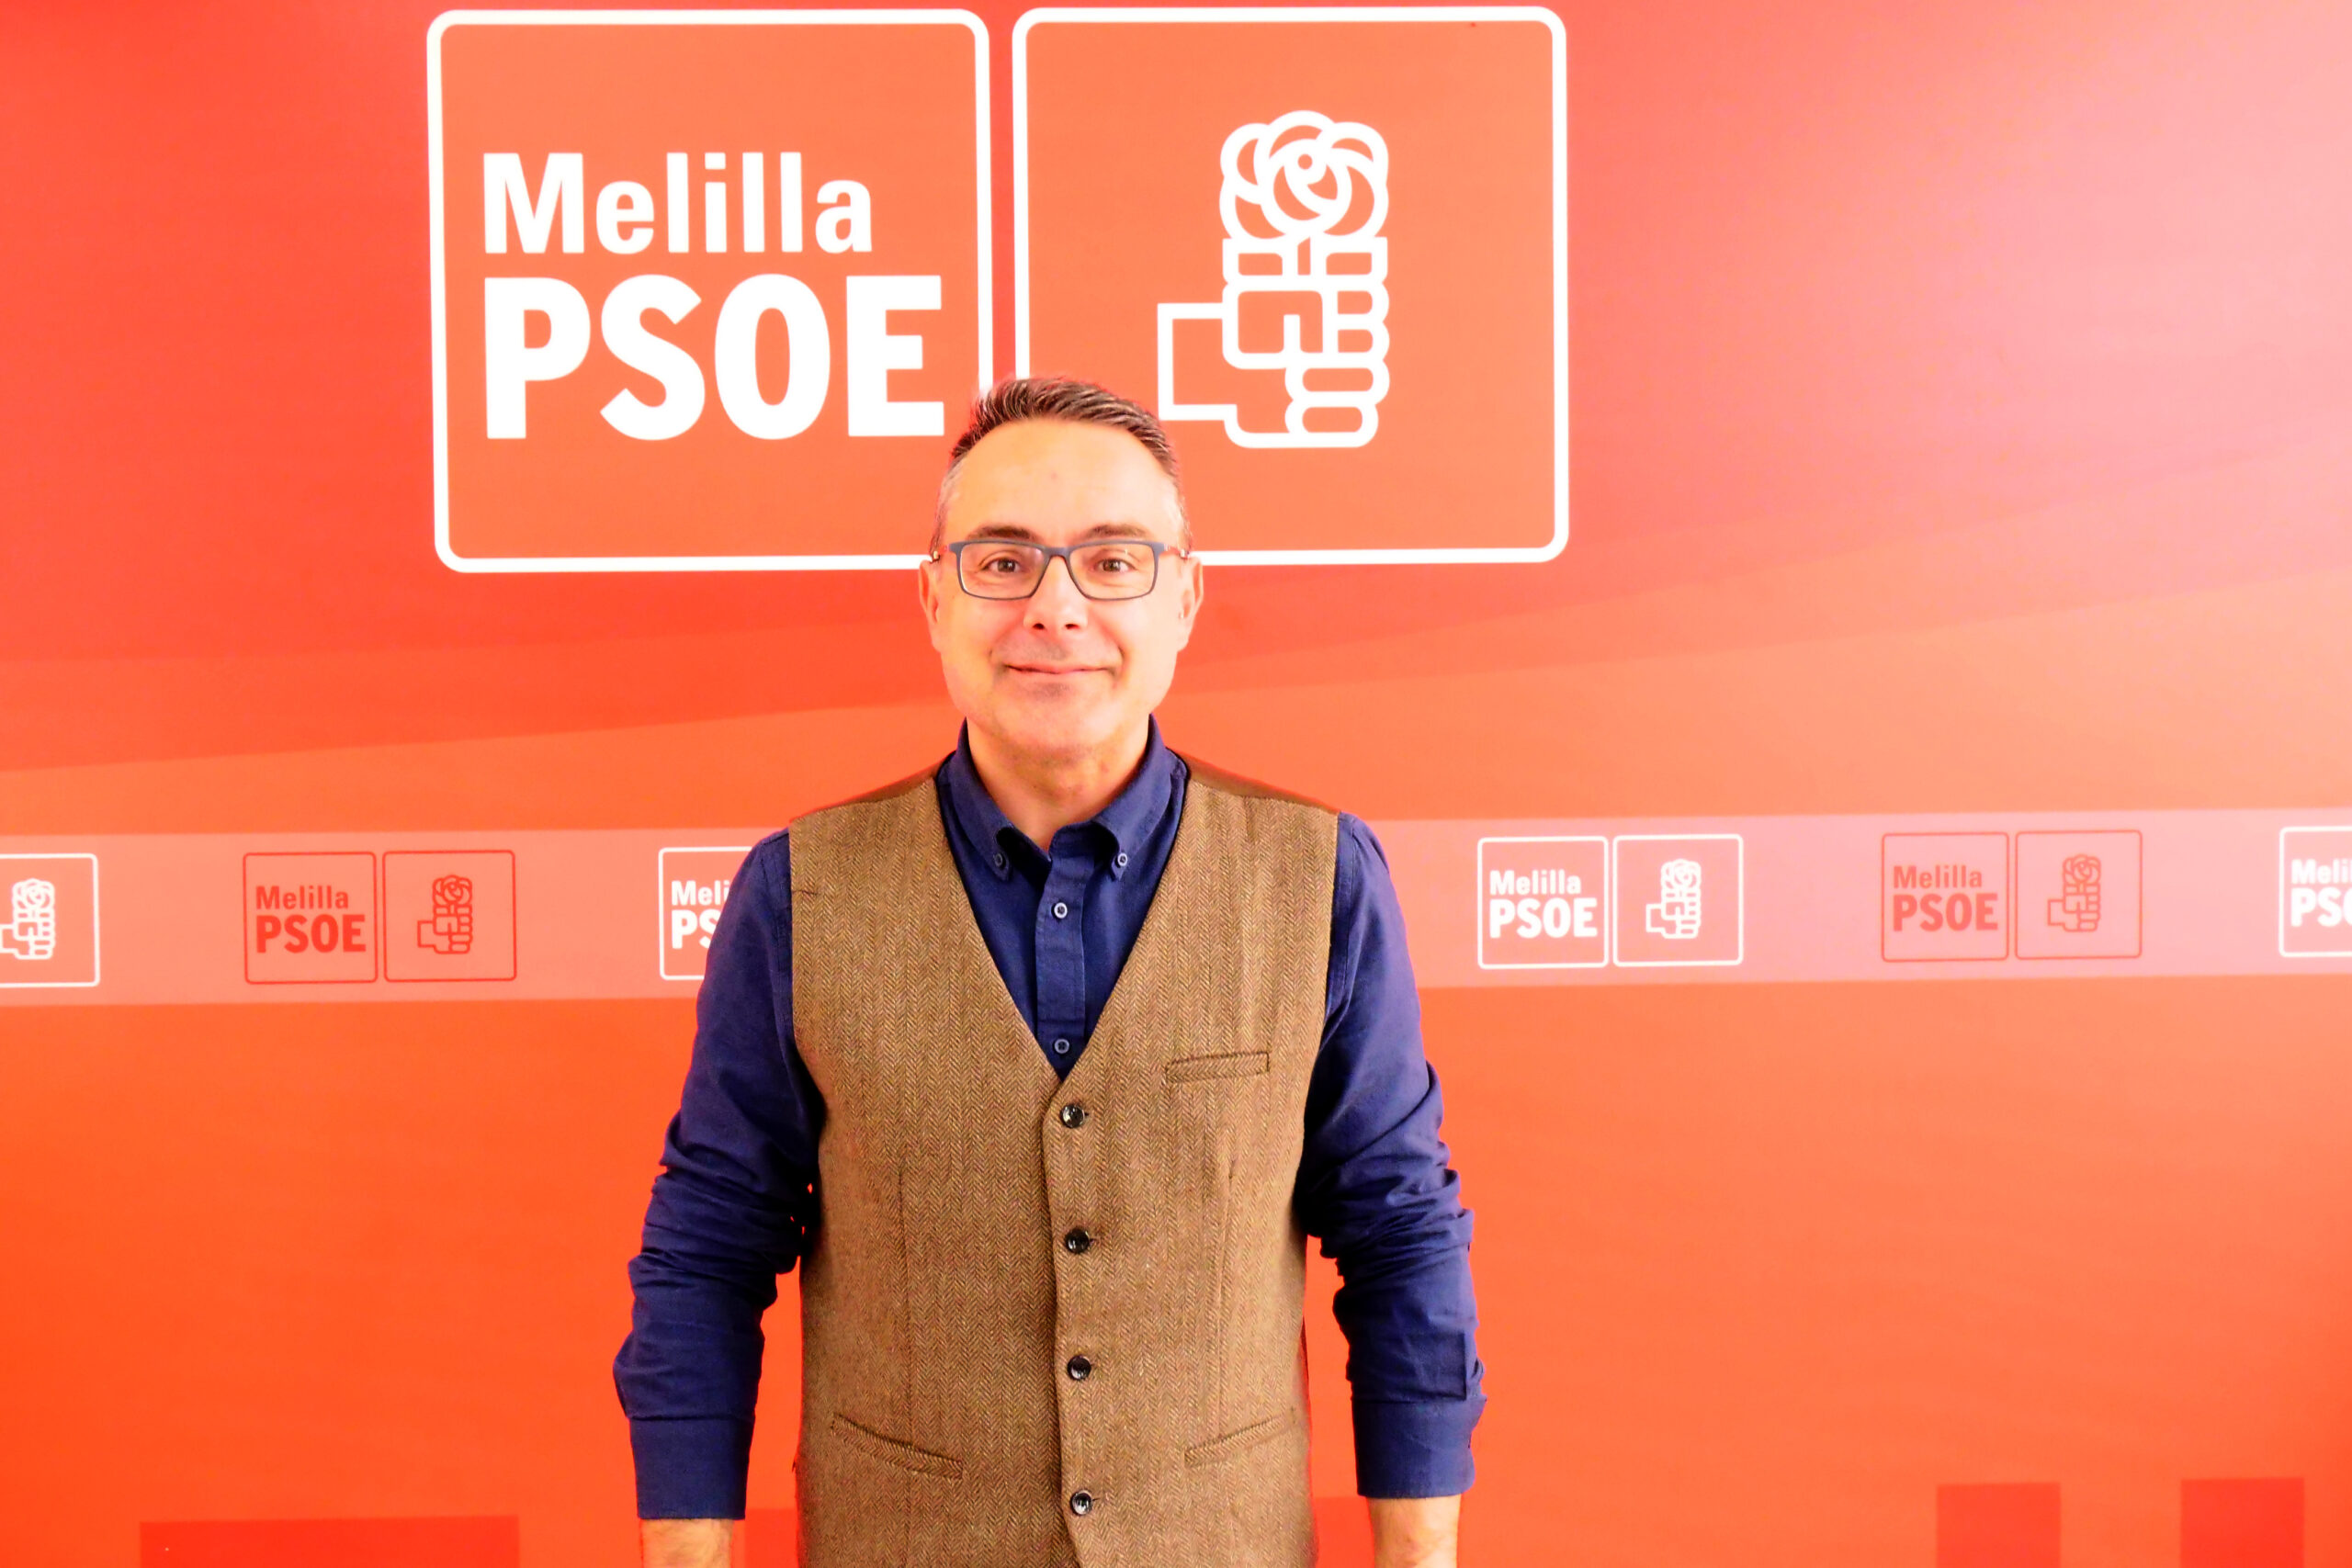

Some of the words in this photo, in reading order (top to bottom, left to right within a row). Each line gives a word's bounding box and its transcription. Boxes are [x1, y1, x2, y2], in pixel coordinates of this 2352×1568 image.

[482, 152, 872, 254] Melilla
[484, 274, 944, 441] PSOE
[1490, 869, 1581, 895] Melilla
[1894, 864, 1983, 888] Melilla
[2291, 858, 2352, 885] Meli
[256, 885, 348, 909] Melilla
[672, 880, 729, 906] Meli
[1894, 893, 1998, 931] PSOE
[2291, 886, 2352, 927] PS
[256, 914, 367, 953] PSOE
[672, 908, 721, 949] PS
[1489, 897, 1598, 938] PSOE
